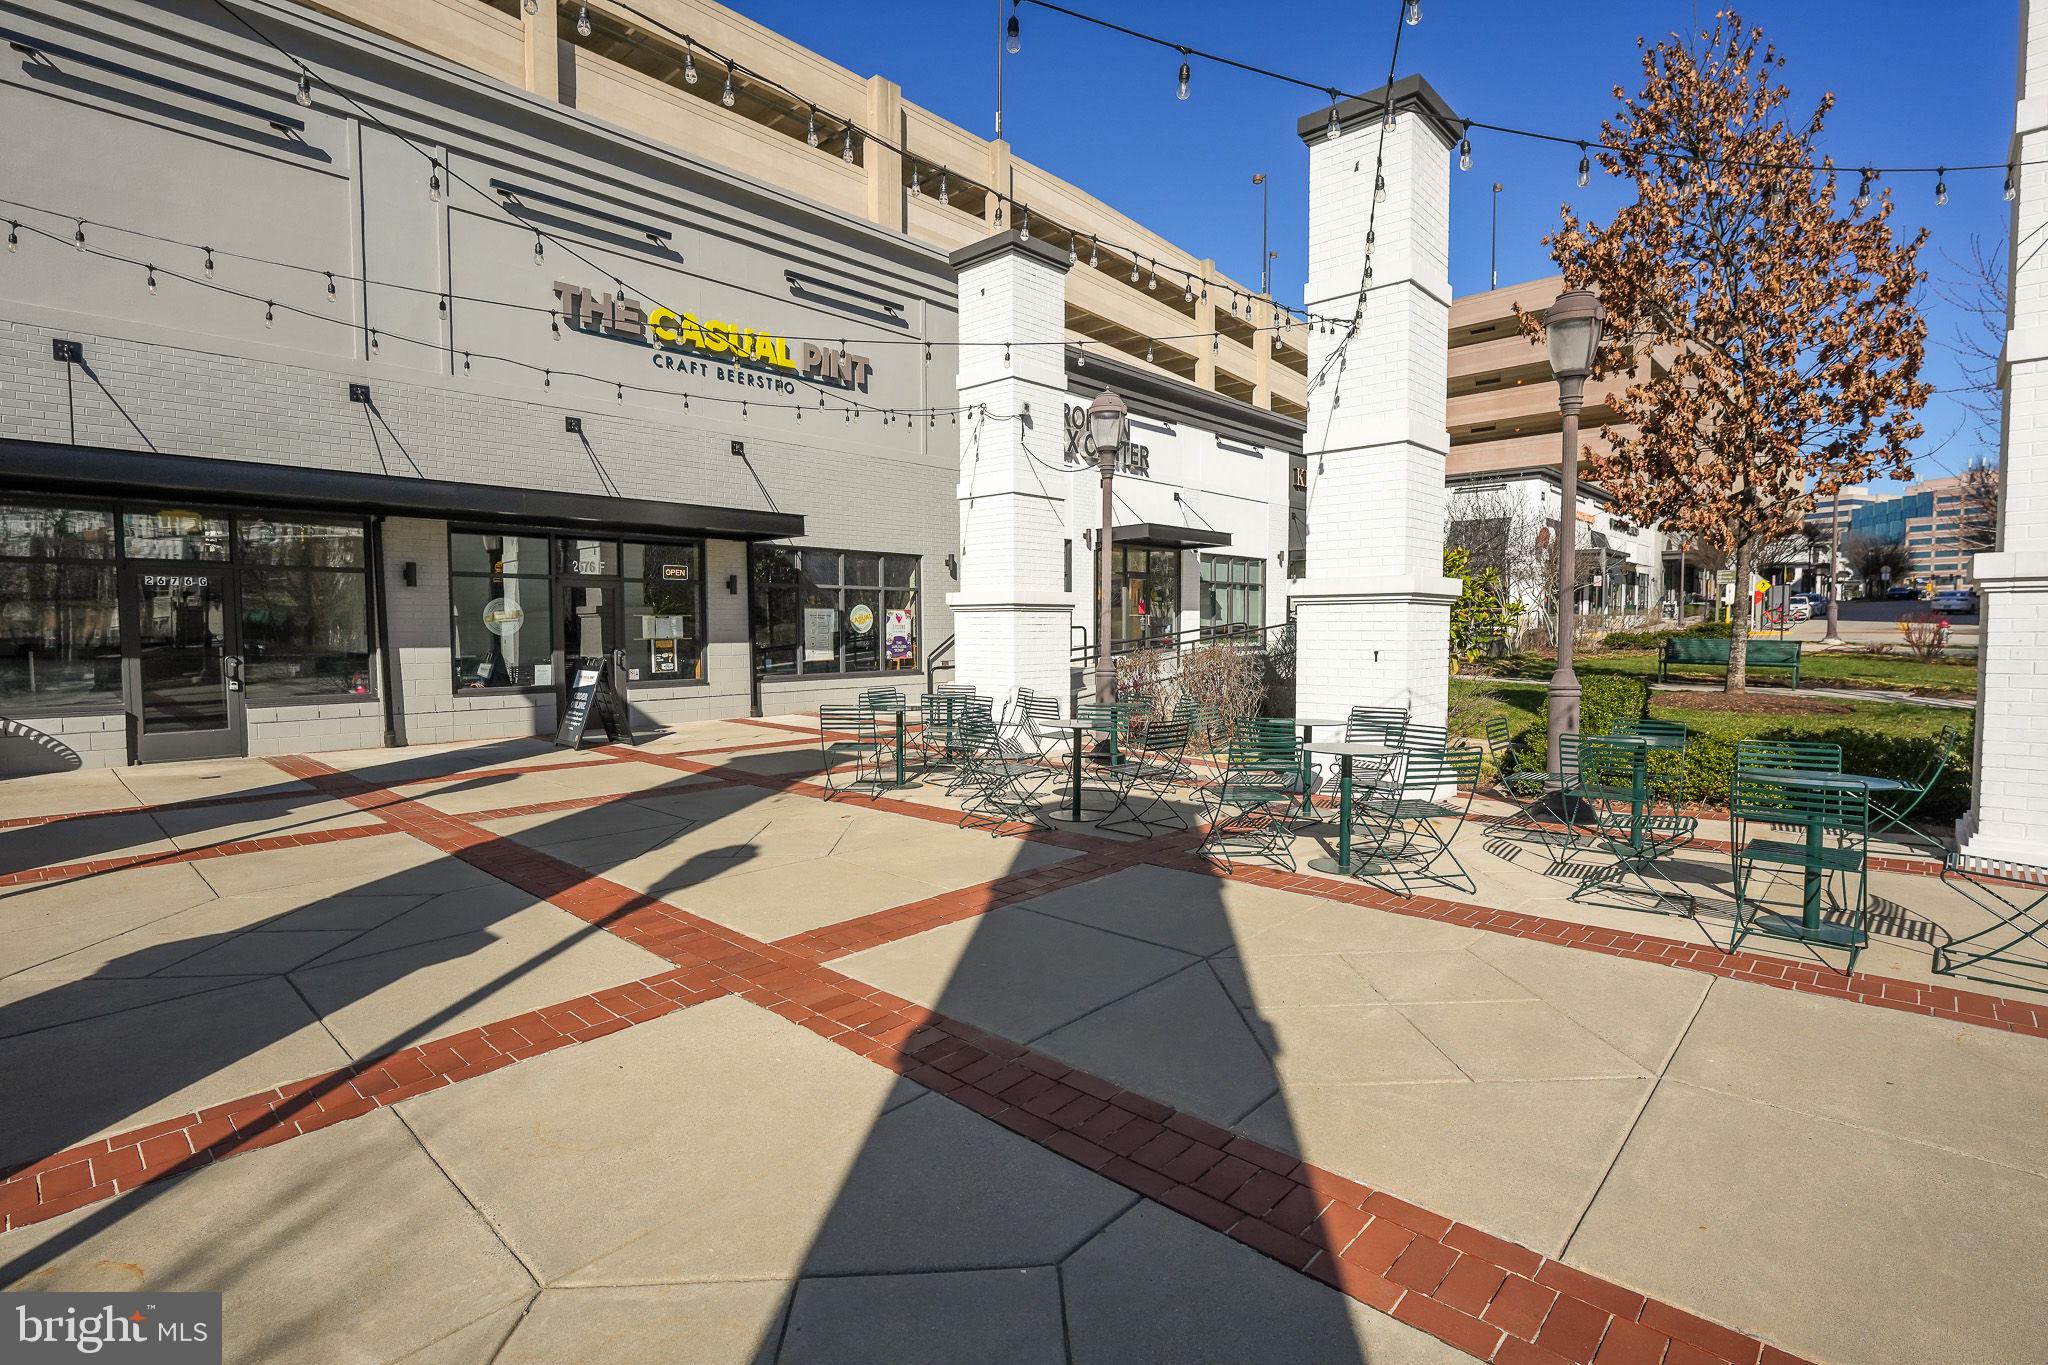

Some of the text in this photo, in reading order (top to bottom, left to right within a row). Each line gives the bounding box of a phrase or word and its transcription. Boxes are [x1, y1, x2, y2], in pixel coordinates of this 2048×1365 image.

[553, 280, 870, 388] THE CASUAL PINT
[652, 353, 709, 378] CRAFT
[1085, 433, 1150, 469] CTER
[572, 561, 596, 573] 2676
[665, 568, 686, 577] OPEN
